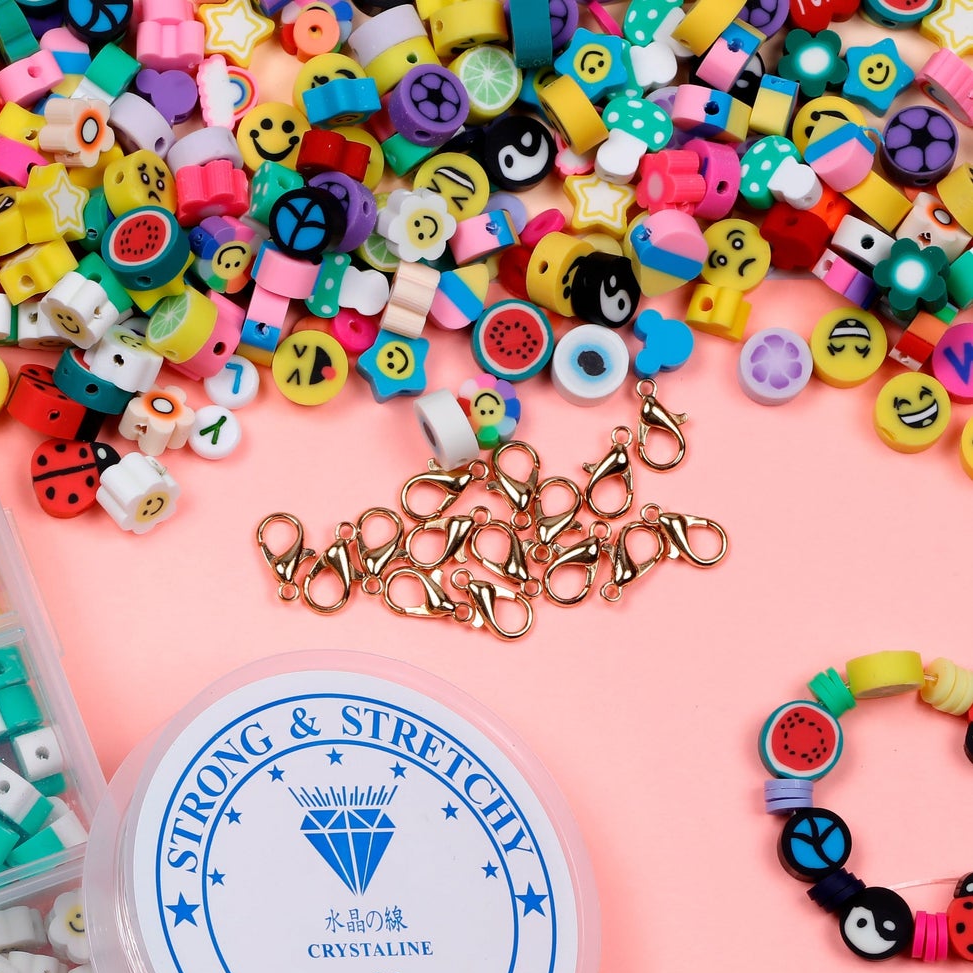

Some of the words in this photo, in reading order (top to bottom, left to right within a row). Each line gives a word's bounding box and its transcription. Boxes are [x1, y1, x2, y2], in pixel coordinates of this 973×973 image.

[167, 721, 273, 873] STRONG
[290, 707, 322, 740] &
[340, 705, 535, 859] STRETCHY
[324, 905, 409, 934] 水晶の線
[307, 941, 435, 959] CRYSTALINE
